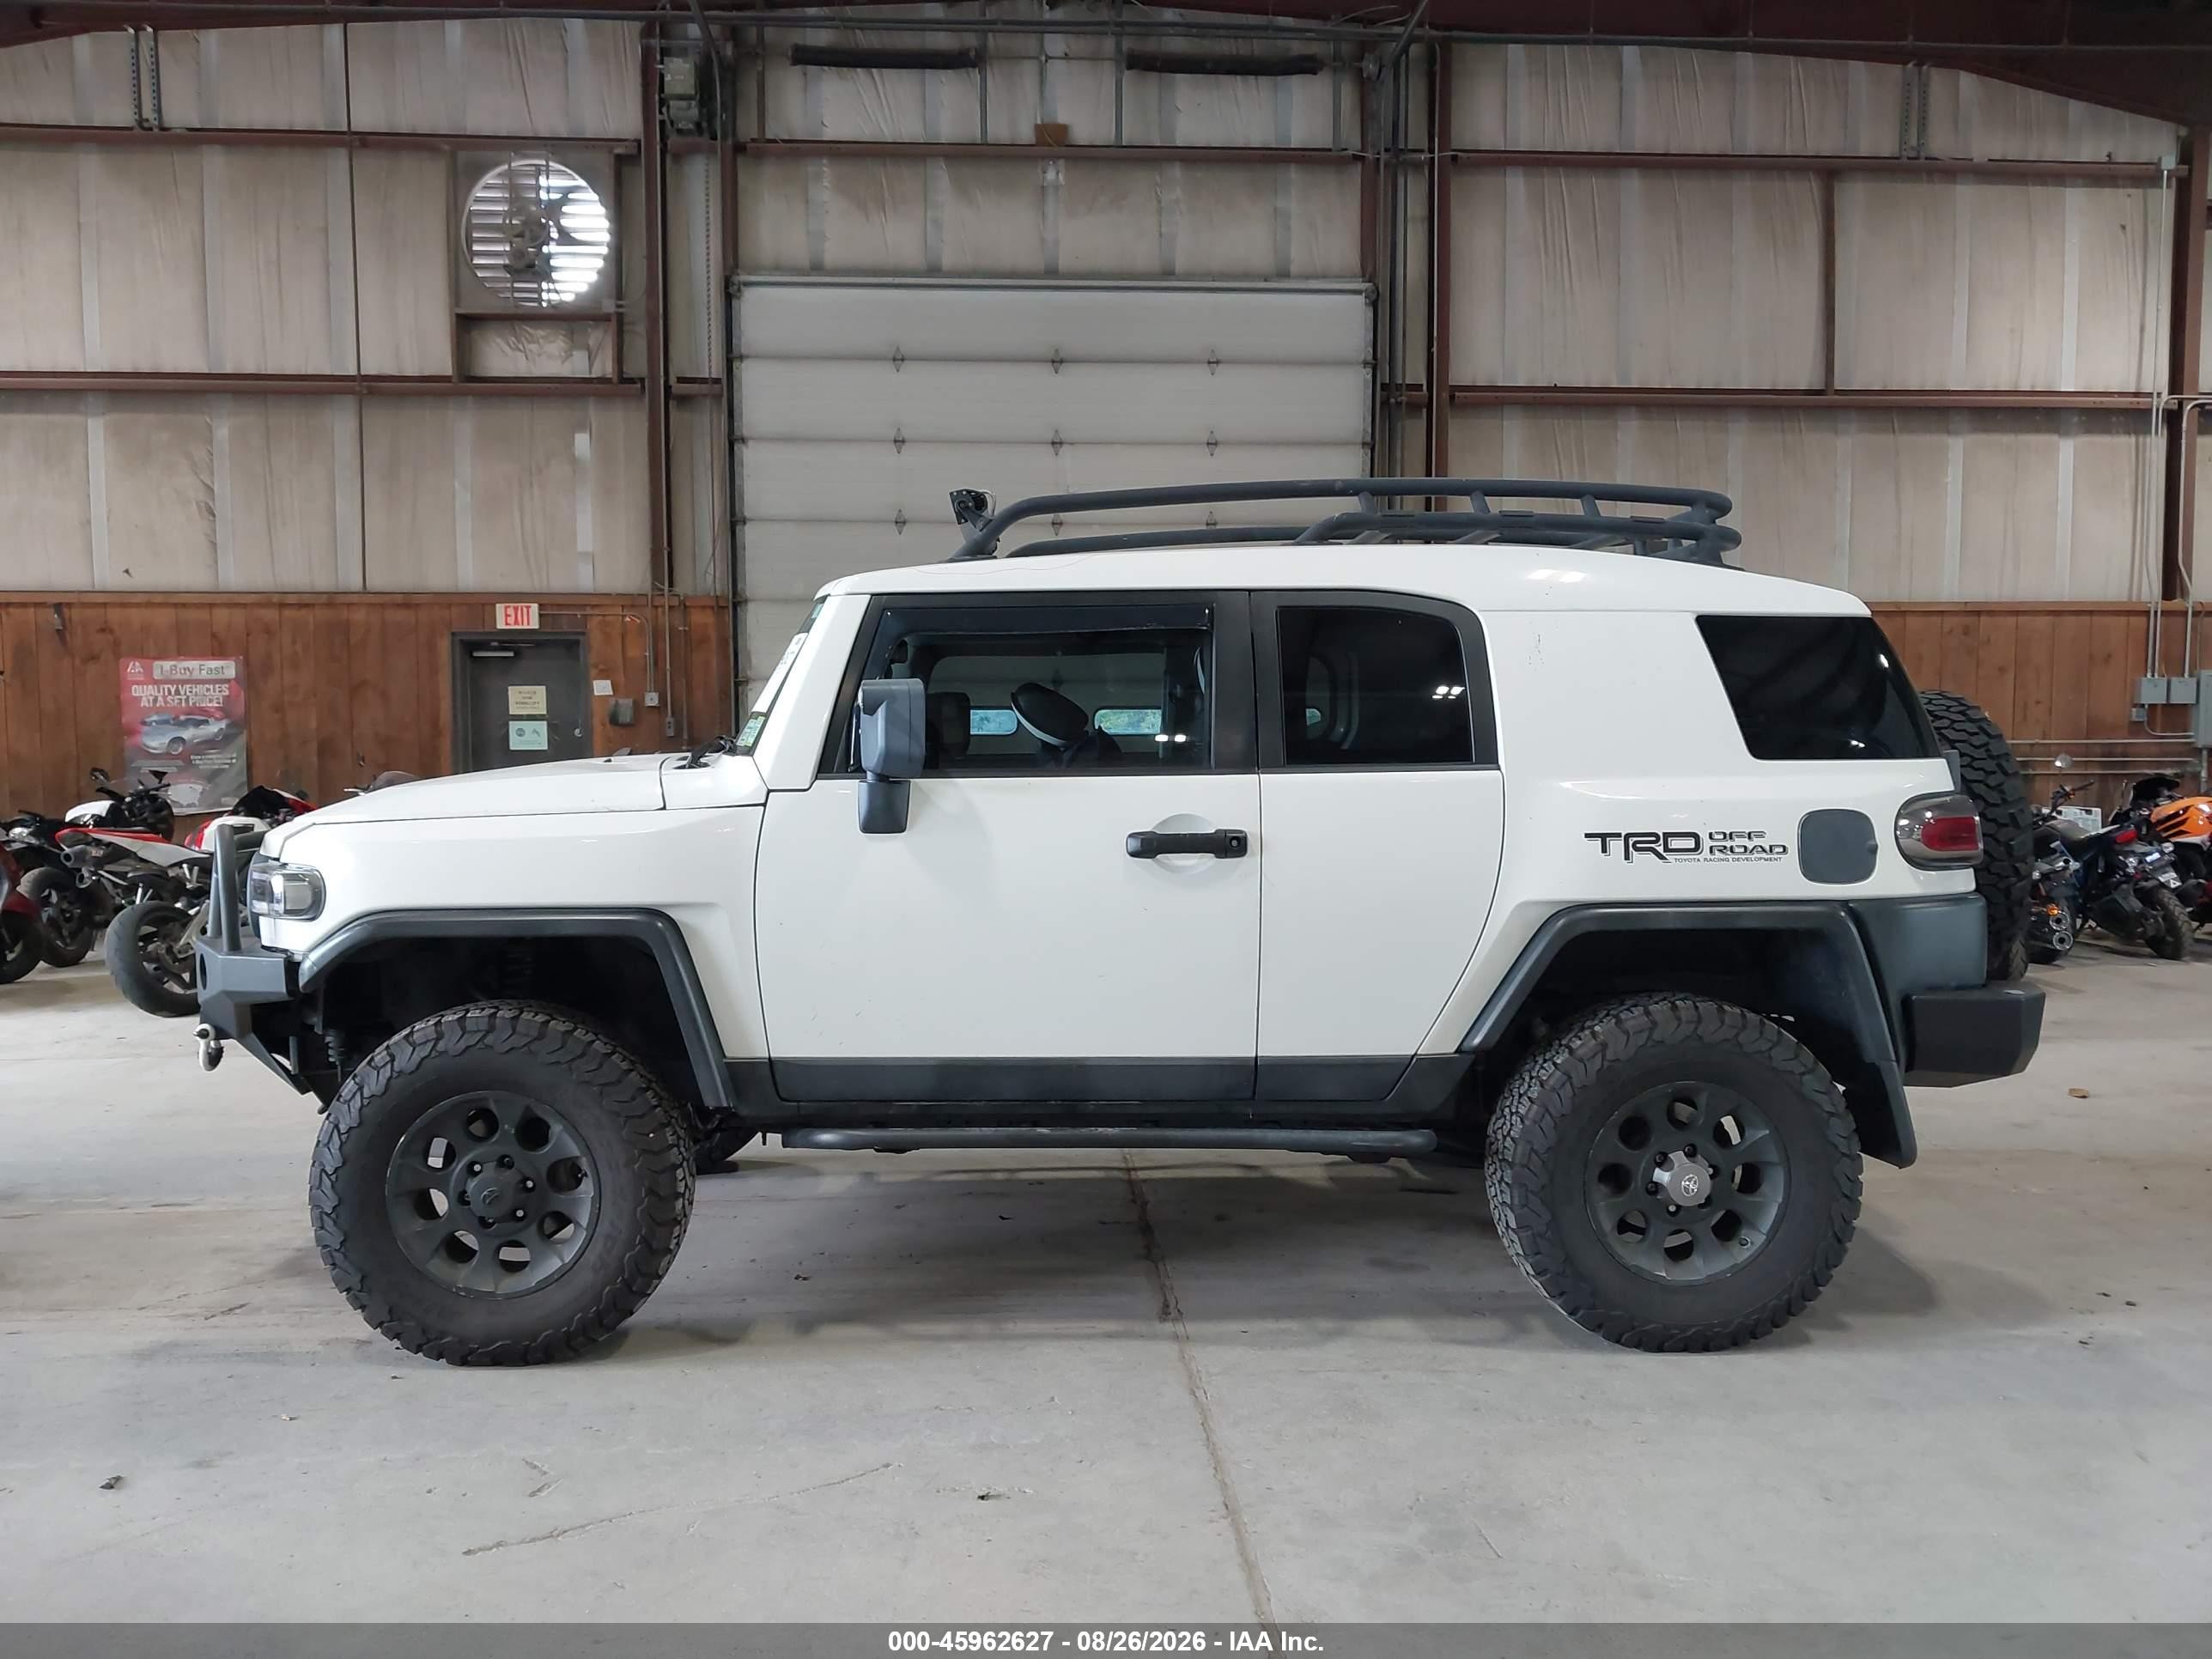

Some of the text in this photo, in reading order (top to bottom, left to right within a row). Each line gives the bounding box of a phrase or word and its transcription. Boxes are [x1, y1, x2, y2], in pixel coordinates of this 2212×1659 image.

[504, 605, 532, 626] EXIT
[198, 665, 225, 676] Fast
[131, 684, 229, 696] QUALITY VEHICLES
[140, 696, 155, 708] AT
[156, 696, 165, 707] A
[167, 696, 186, 707] SET
[1708, 830, 1767, 842] OFF
[1584, 831, 1705, 864] TRD
[1709, 844, 1789, 855] ROAD
